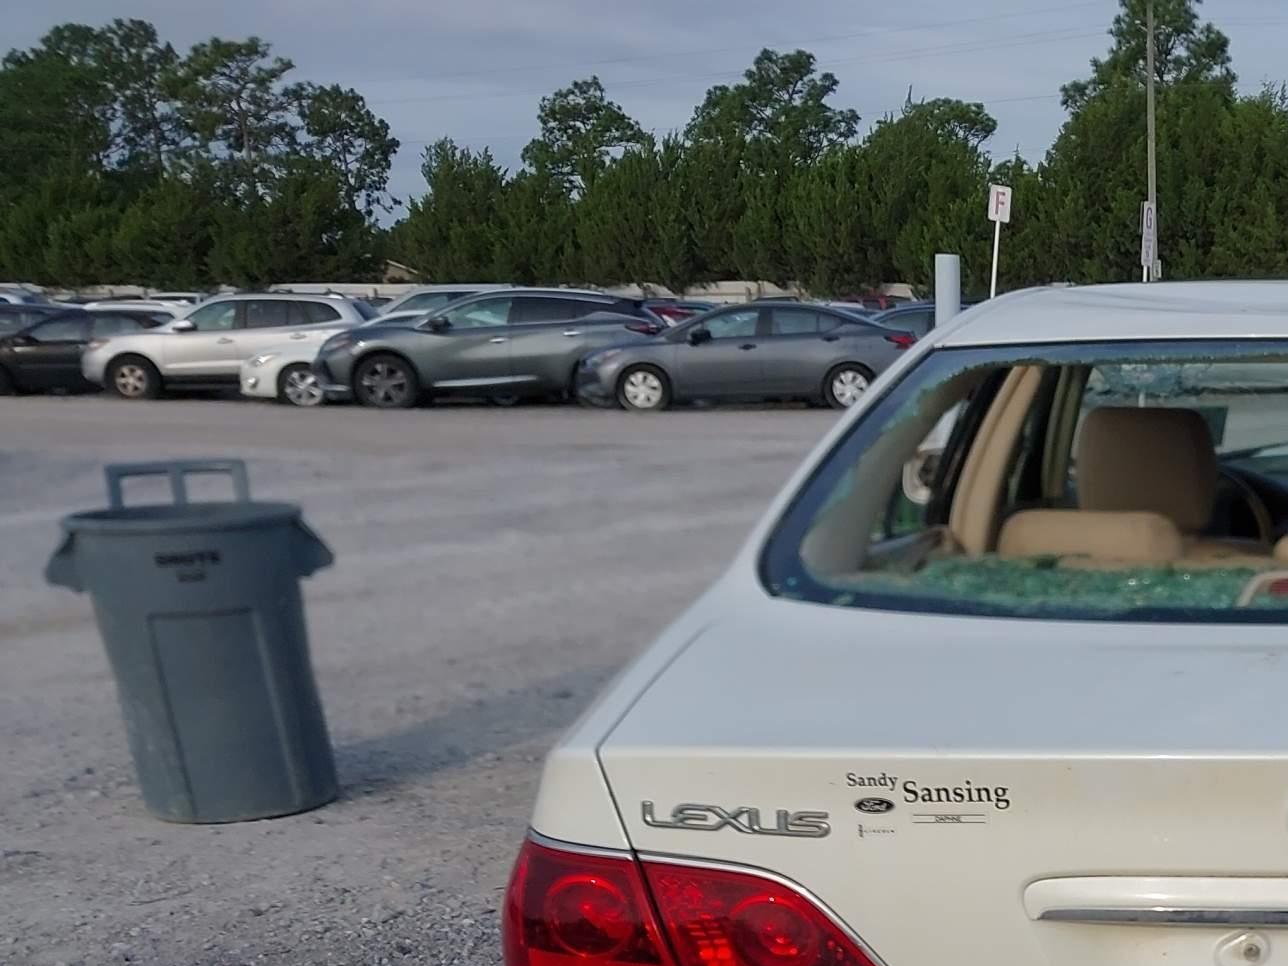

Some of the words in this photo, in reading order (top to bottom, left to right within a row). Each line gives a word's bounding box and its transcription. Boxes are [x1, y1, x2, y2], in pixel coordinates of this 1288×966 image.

[995, 191, 1006, 215] F
[1146, 206, 1153, 229] G
[846, 772, 898, 791] Sandy
[902, 780, 1010, 810] Sansing
[642, 800, 831, 838] LEXUS
